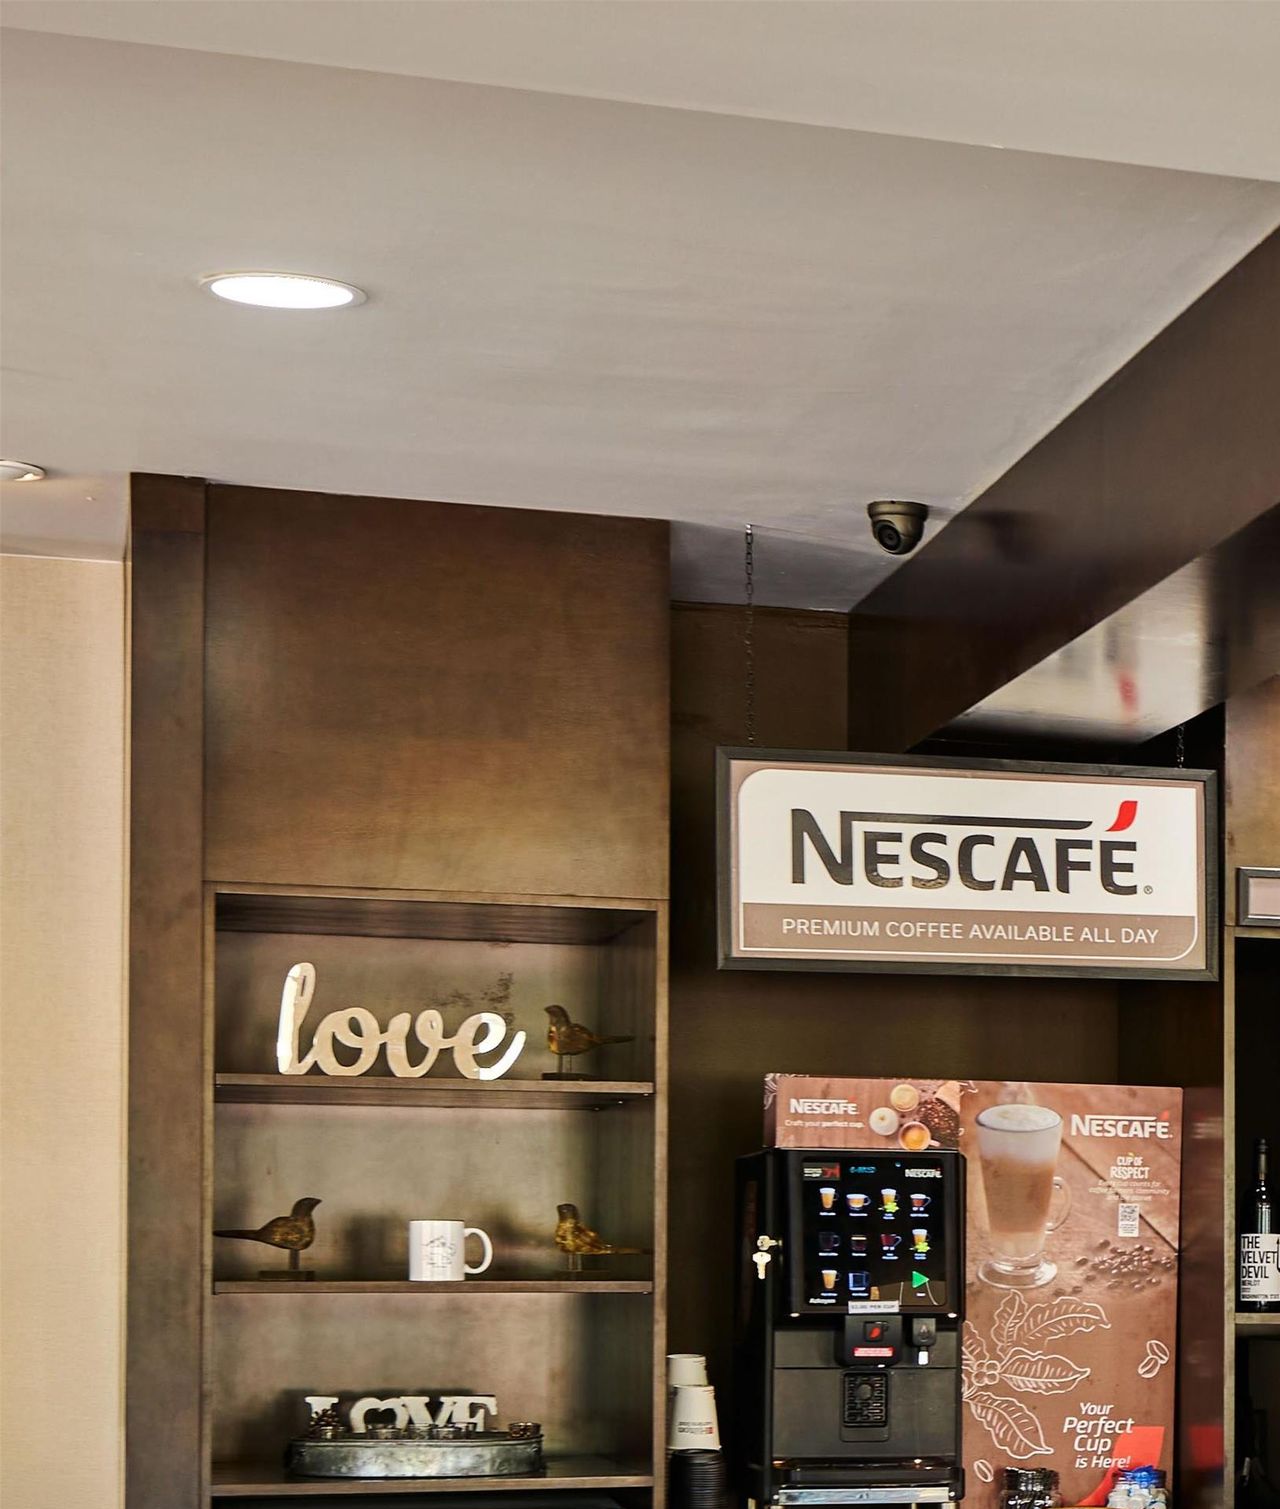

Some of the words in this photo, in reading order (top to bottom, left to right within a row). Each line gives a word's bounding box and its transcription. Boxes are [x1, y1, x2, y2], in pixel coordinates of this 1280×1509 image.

[790, 800, 1139, 896] NESCAFÉ
[782, 917, 880, 937] PREMIUM
[885, 921, 964, 940] COFFEE
[969, 924, 1075, 943] AVAILABLE
[1081, 926, 1116, 943] ALL
[1120, 928, 1159, 945] DAY
[276, 961, 527, 1081] love
[1110, 1166, 1150, 1179] RESPECT
[1241, 1235, 1261, 1249] THE
[1241, 1250, 1278, 1264] VELVET
[1241, 1265, 1270, 1279] DEVIL
[1080, 1402, 1115, 1415] Your
[1063, 1416, 1135, 1438] Perfect
[1073, 1434, 1112, 1455] Cup
[1075, 1454, 1088, 1468] is
[1091, 1455, 1131, 1469] Here!
